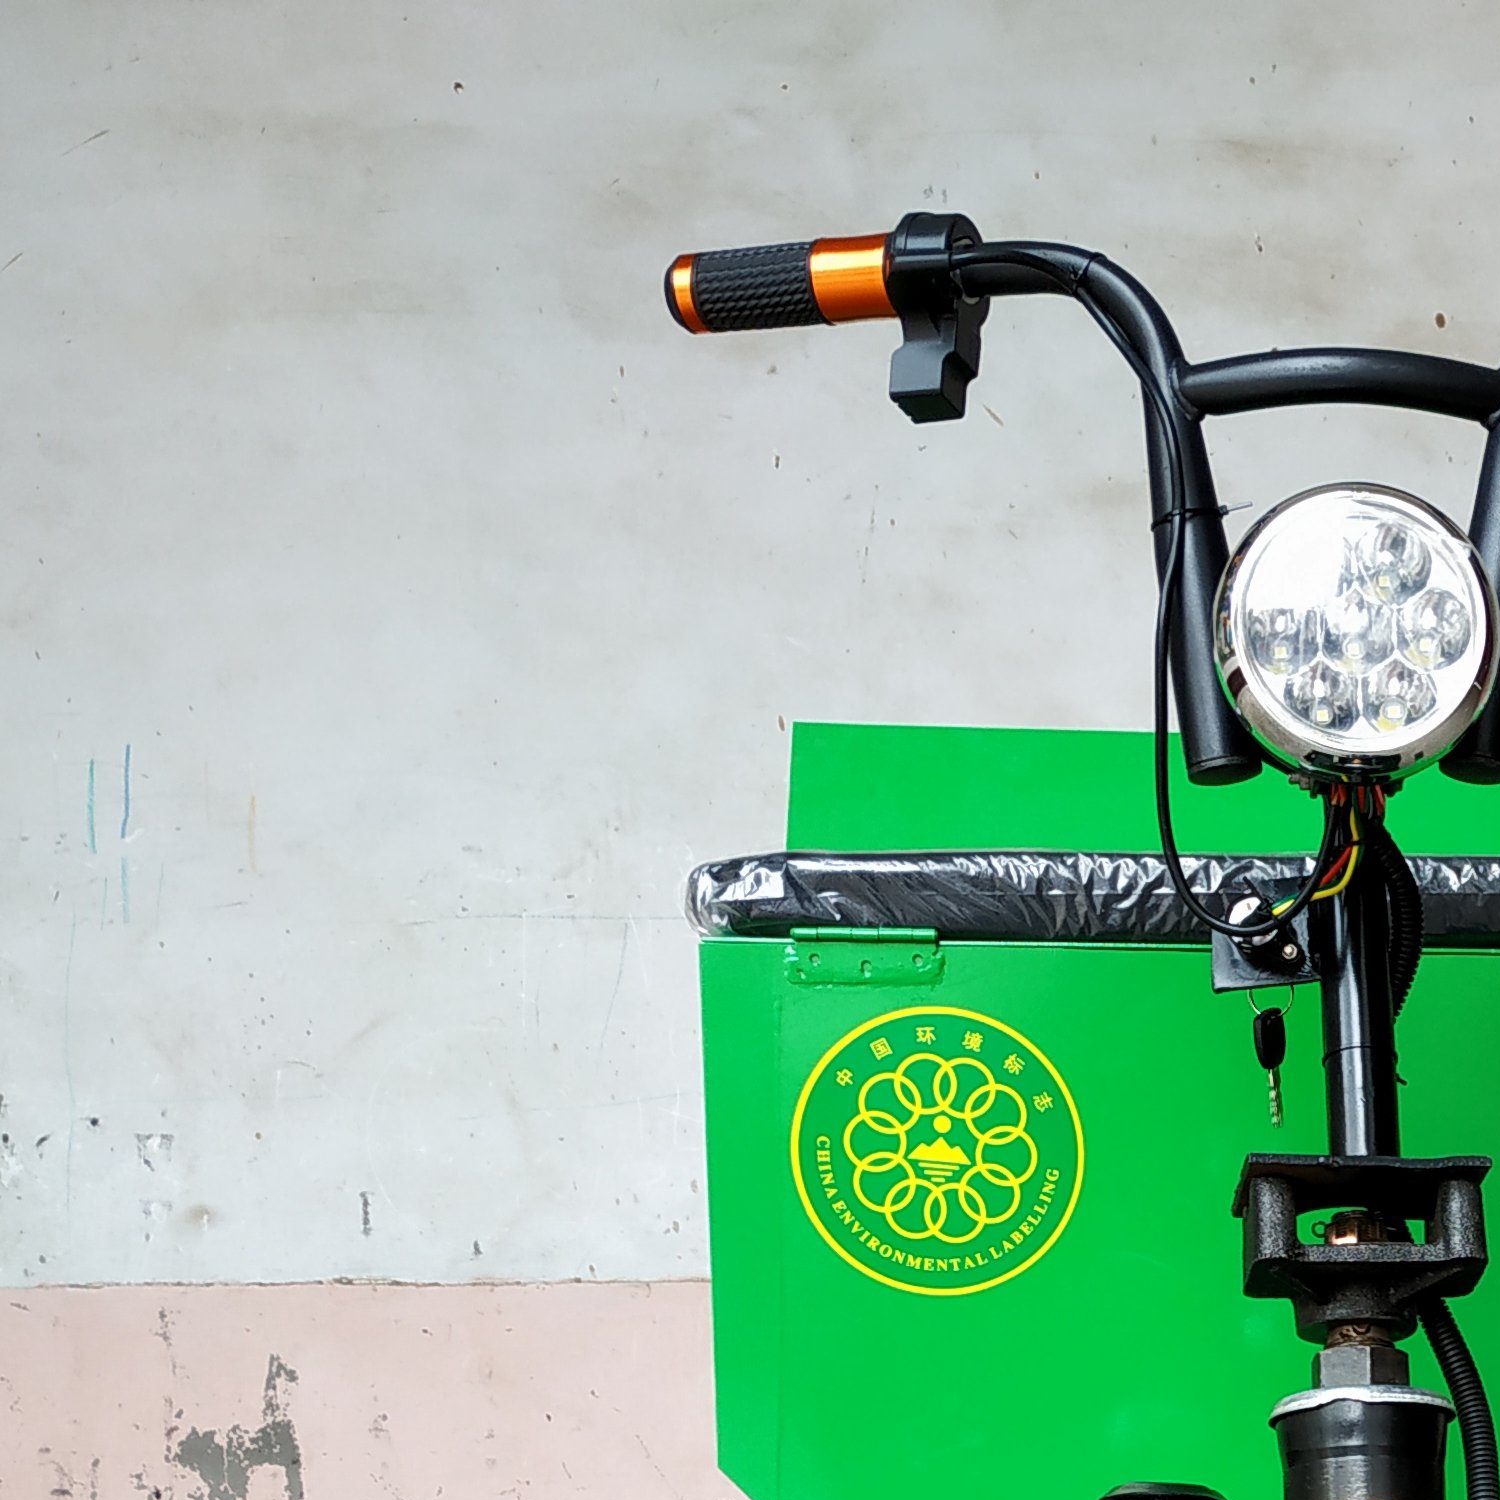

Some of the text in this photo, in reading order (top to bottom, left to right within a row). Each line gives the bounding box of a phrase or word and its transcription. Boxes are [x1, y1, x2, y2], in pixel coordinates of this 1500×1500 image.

[835, 1026, 1054, 1113] 中国环境标志
[816, 1135, 1060, 1272] CHINA ENVIRONMENTAL LABELLING
